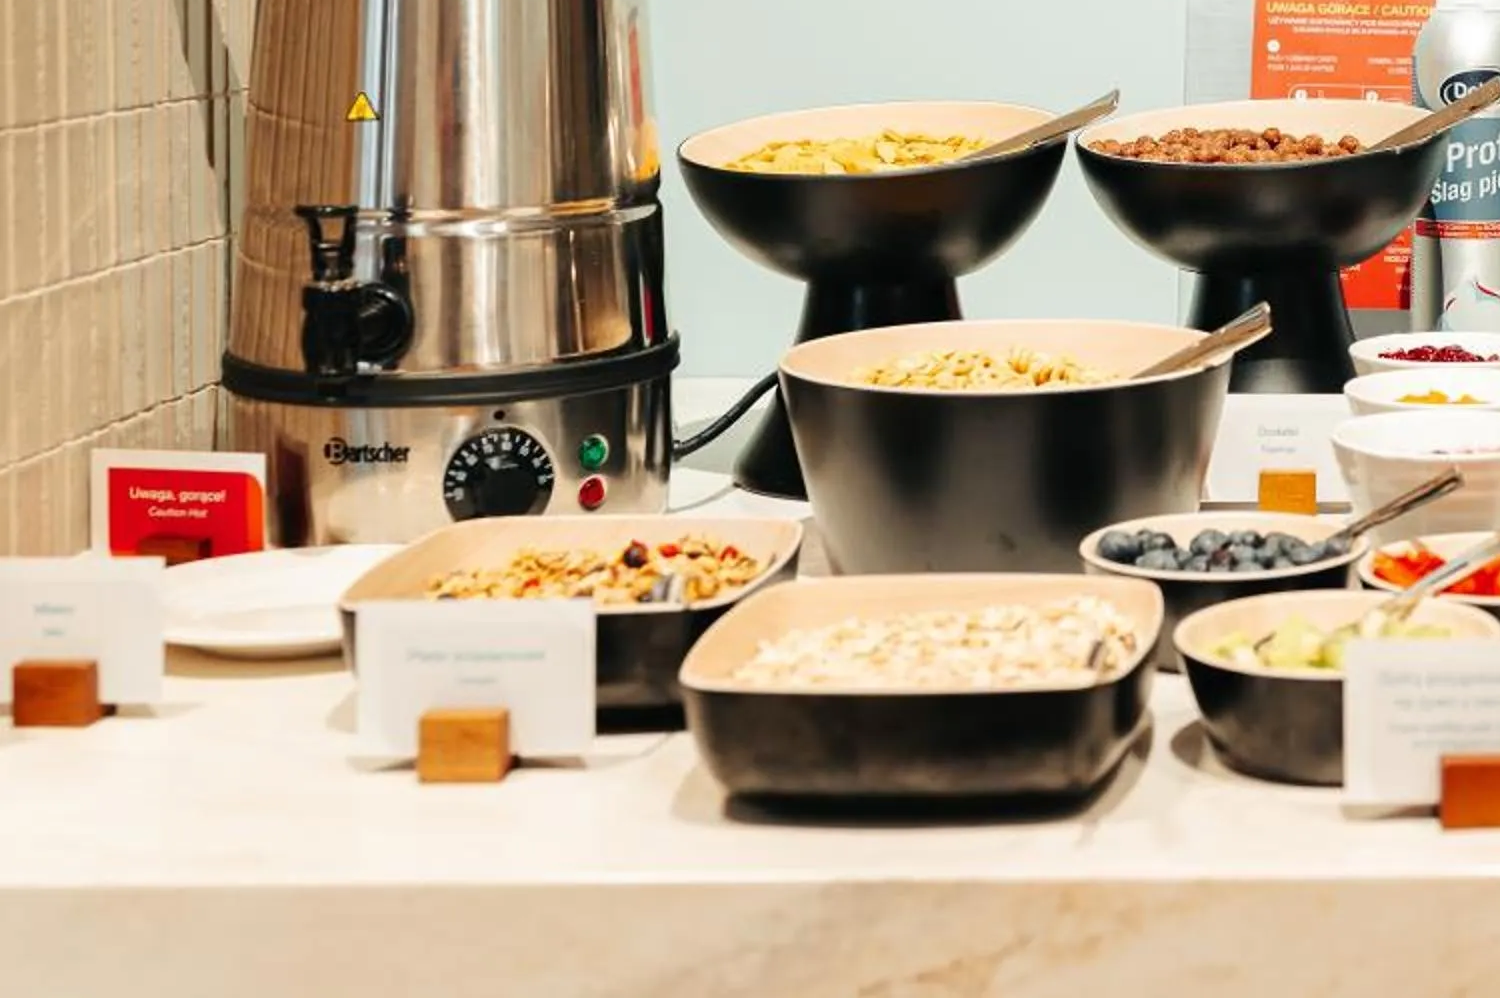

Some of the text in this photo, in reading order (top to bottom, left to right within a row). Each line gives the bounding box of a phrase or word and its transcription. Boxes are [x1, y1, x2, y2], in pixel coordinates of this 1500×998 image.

[1266, 1, 1315, 14] UWAGA
[1380, 4, 1433, 18] CAUTIO
[323, 437, 411, 464] Bartscher
